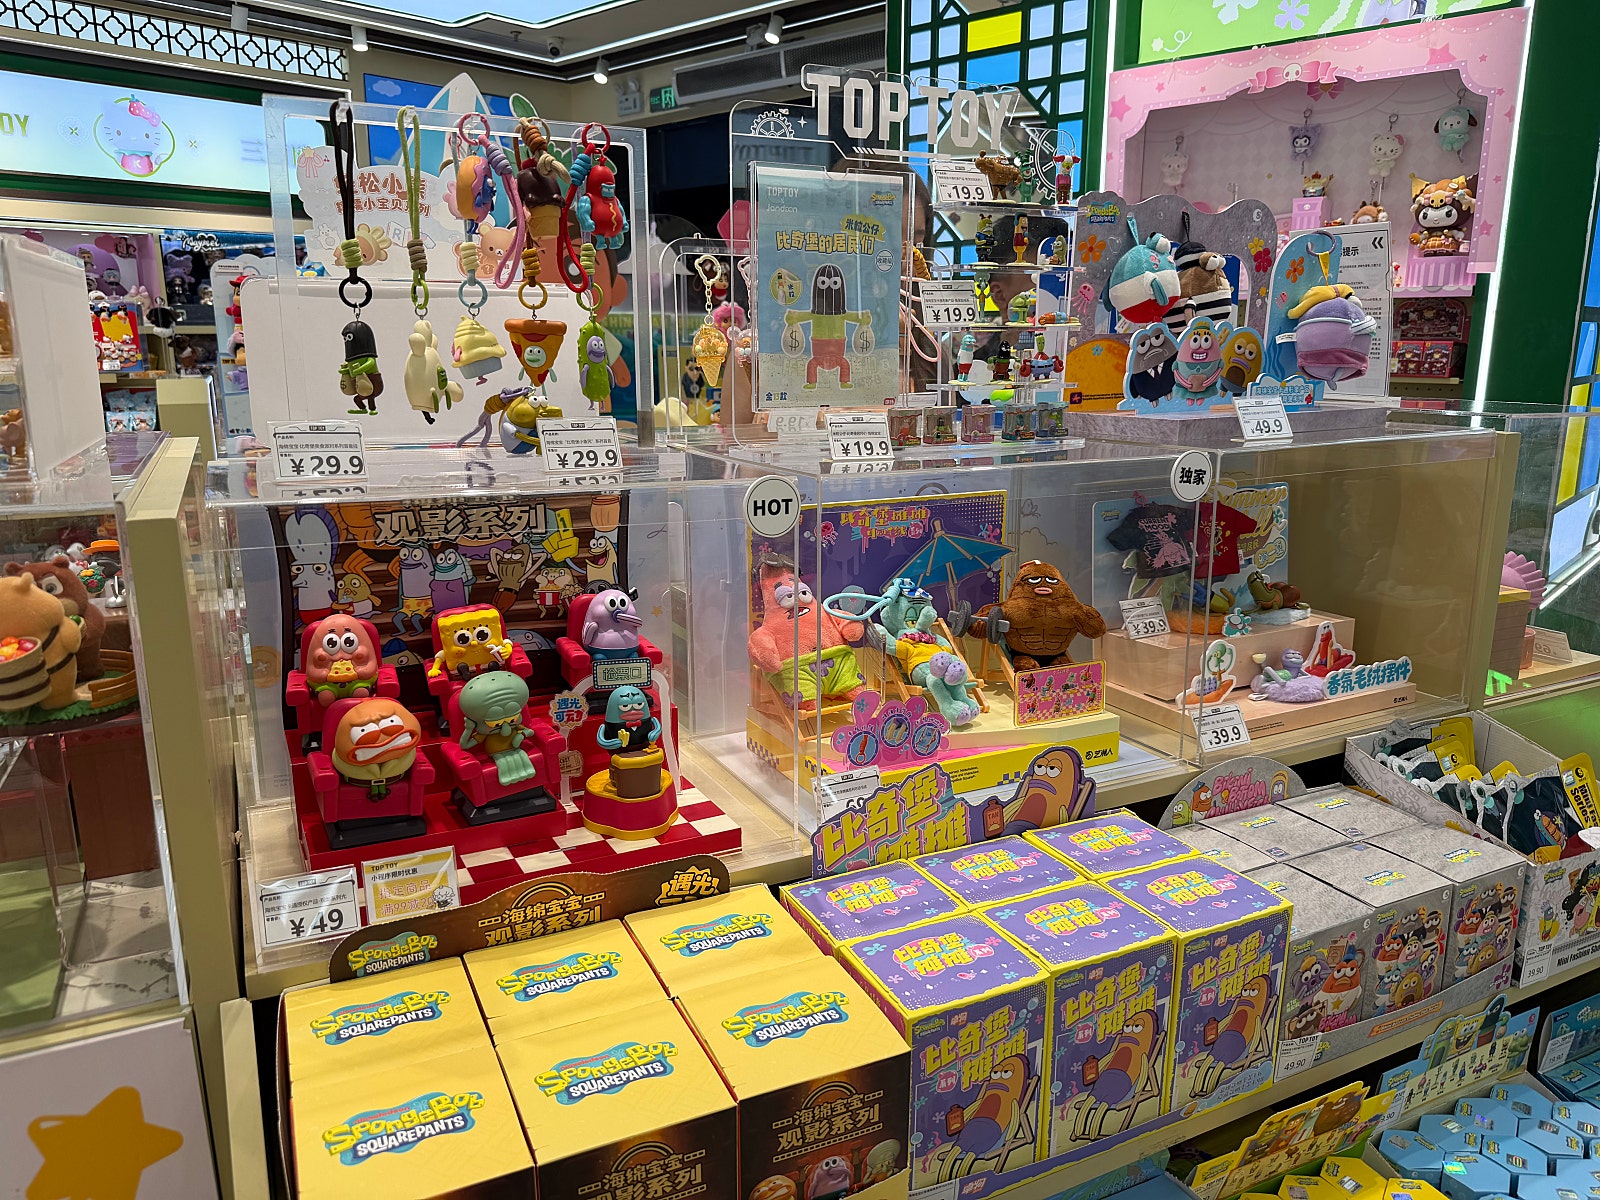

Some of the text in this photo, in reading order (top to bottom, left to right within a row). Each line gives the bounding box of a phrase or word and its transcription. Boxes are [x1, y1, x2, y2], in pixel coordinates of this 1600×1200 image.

[806, 73, 1013, 150] TOP TOY
[776, 230, 876, 255] 比奇堡的居民们
[845, 218, 880, 236] 米粒公仔
[1341, 246, 1359, 257] 提示
[1179, 467, 1207, 486] 独家
[753, 498, 793, 517] HOT
[374, 504, 546, 545] 观影系列
[1327, 660, 1411, 696] 香氛毛绒摆件
[821, 769, 941, 870] 比奇堡
[1570, 787, 1590, 823] Series
[1068, 825, 1125, 844] 比奇堡
[371, 864, 385, 872] TOP
[951, 849, 1011, 870] 比奇堡
[827, 877, 892, 902] 比奇堡
[1146, 871, 1207, 895] 比奇堡
[502, 895, 583, 925] 海绵宝宝
[1025, 898, 1090, 924] 比奇堡
[485, 905, 602, 947] 观影系列
[660, 914, 774, 952] SpongeBob
[689, 926, 764, 952] SQUAREPANTS
[347, 935, 438, 971] SpongeBob
[366, 952, 425, 973] SQUAREPANTS
[893, 932, 964, 962] 比奇堡
[1192, 930, 1261, 991] 比奇堡
[496, 952, 623, 995] SpongeBob
[526, 967, 610, 996] SQUAREPANTS
[1528, 966, 1544, 978] 39.90
[1066, 962, 1141, 1028] 比奇堡
[310, 992, 451, 1038] SpongeBob
[340, 1008, 433, 1038] SQUAREPANTS
[721, 992, 850, 1040] SpongeBob
[755, 1009, 840, 1040] SQUAREPANTS
[926, 1006, 1010, 1075] 比奇堡
[534, 1043, 678, 1097] SpongeBob
[569, 1062, 665, 1098] SQUAREPANTS
[1284, 1058, 1306, 1071] 49.90
[940, 1076, 956, 1088] 系列
[322, 1094, 485, 1156] SpongeBob
[794, 1094, 864, 1126] 海绵宝宝
[356, 1116, 465, 1157] SQUAREPANTS
[778, 1100, 880, 1152] 观影系列
[602, 1153, 683, 1189] 海绵宝宝
